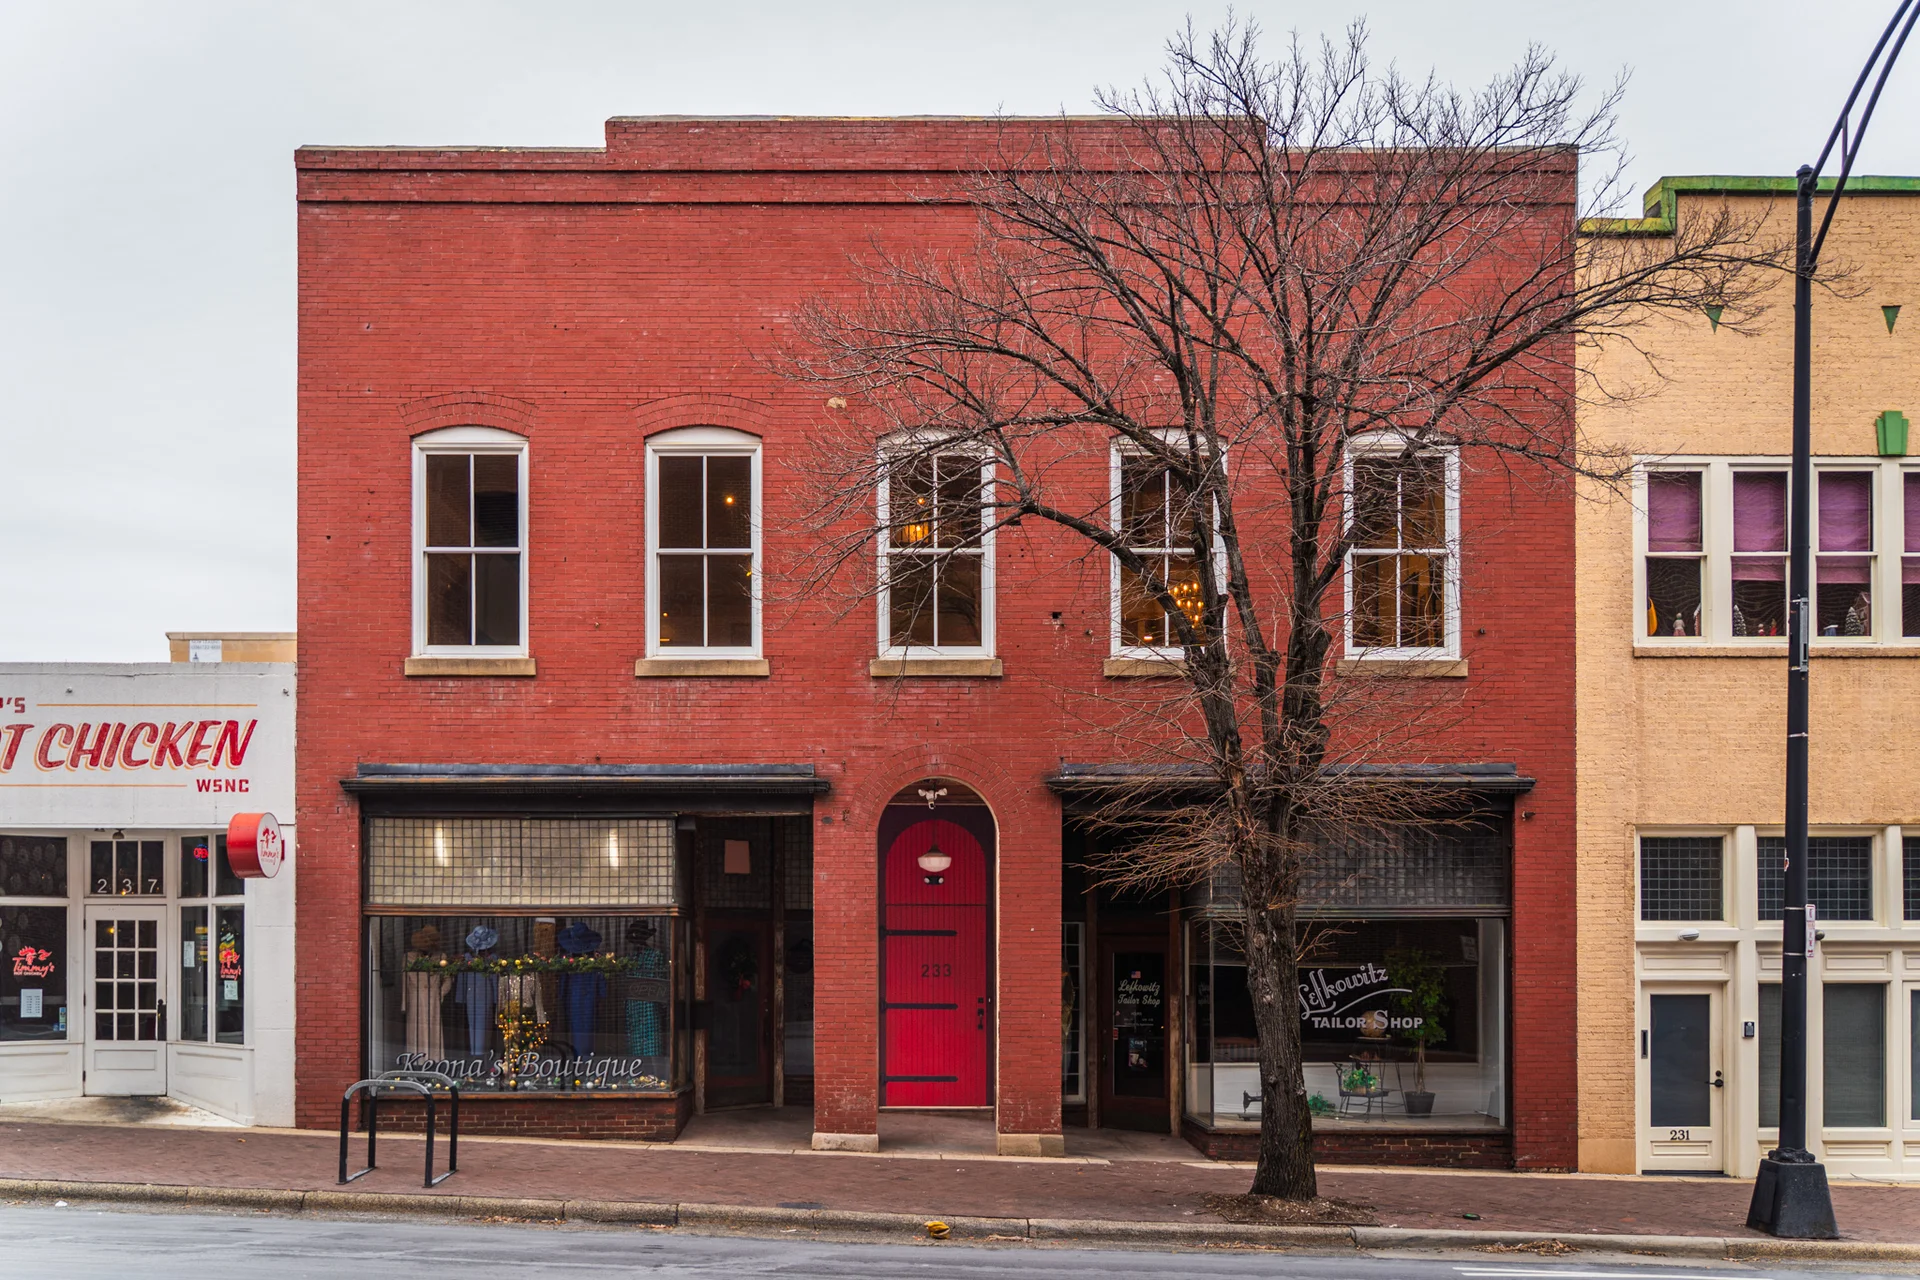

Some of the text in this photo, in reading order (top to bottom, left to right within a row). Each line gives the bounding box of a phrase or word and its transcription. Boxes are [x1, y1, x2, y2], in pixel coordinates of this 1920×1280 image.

[0, 719, 258, 773] T CHICKEN
[196, 779, 249, 793] WSNC
[97, 878, 158, 894] 237
[12, 957, 55, 978] Timmy's
[921, 963, 952, 978] 233
[1118, 979, 1160, 996] Lefkowitz
[1299, 963, 1388, 1020] Lefkowitz
[1118, 993, 1160, 1007] Tailor Shop
[1311, 1010, 1423, 1029] TAILOR SHOP
[396, 1049, 643, 1089] Keona's Boutique
[1670, 1129, 1690, 1141] 231
